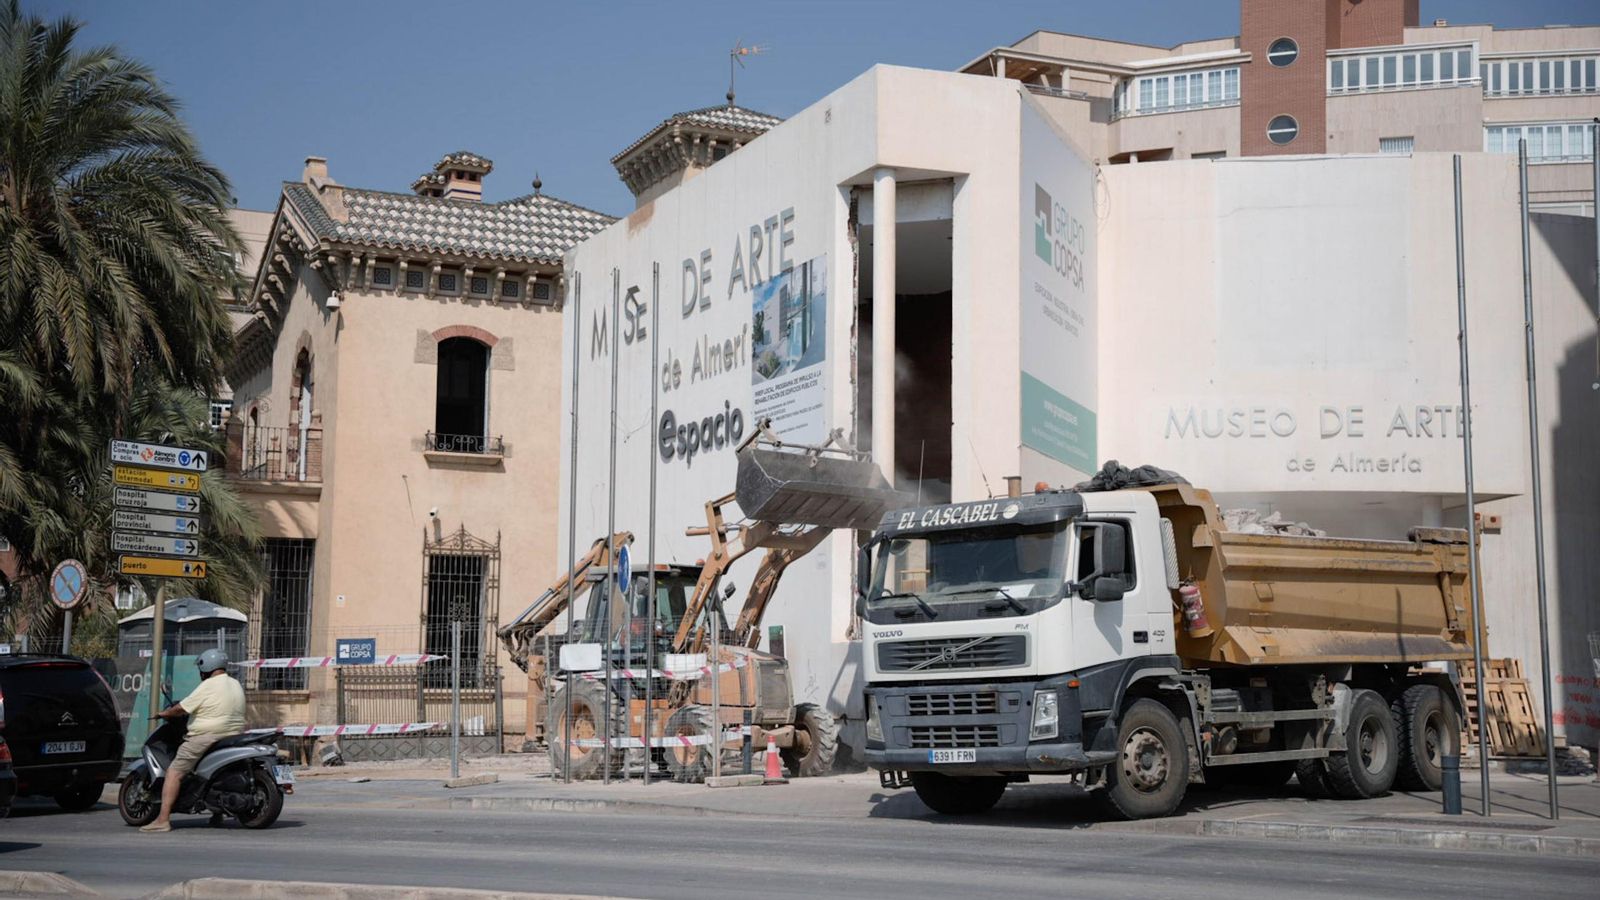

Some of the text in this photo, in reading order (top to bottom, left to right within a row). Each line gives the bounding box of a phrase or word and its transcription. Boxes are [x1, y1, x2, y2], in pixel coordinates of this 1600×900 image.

[1054, 202, 1085, 255] GRUPO
[682, 248, 713, 320] DE
[727, 206, 795, 301] ARTE
[1054, 239, 1085, 293] COPSA
[661, 347, 682, 393] de
[1164, 405, 1473, 440] MUSEO DE ARTE
[658, 399, 744, 469] espacio
[1286, 452, 1422, 474] de Almería
[117, 475, 153, 484] intermodal
[117, 490, 147, 499] hospital
[133, 500, 147, 508] roja
[117, 512, 146, 521] hospital
[897, 502, 999, 530] EL CASCABEL
[116, 520, 152, 529] provincial
[116, 534, 145, 543] hospital
[872, 630, 903, 638] VOLVO
[350, 643, 372, 651] GRUPO
[350, 651, 372, 659] COPSA
[47, 743, 85, 753] 2041 GJV
[934, 750, 974, 762] 6391 FRN
